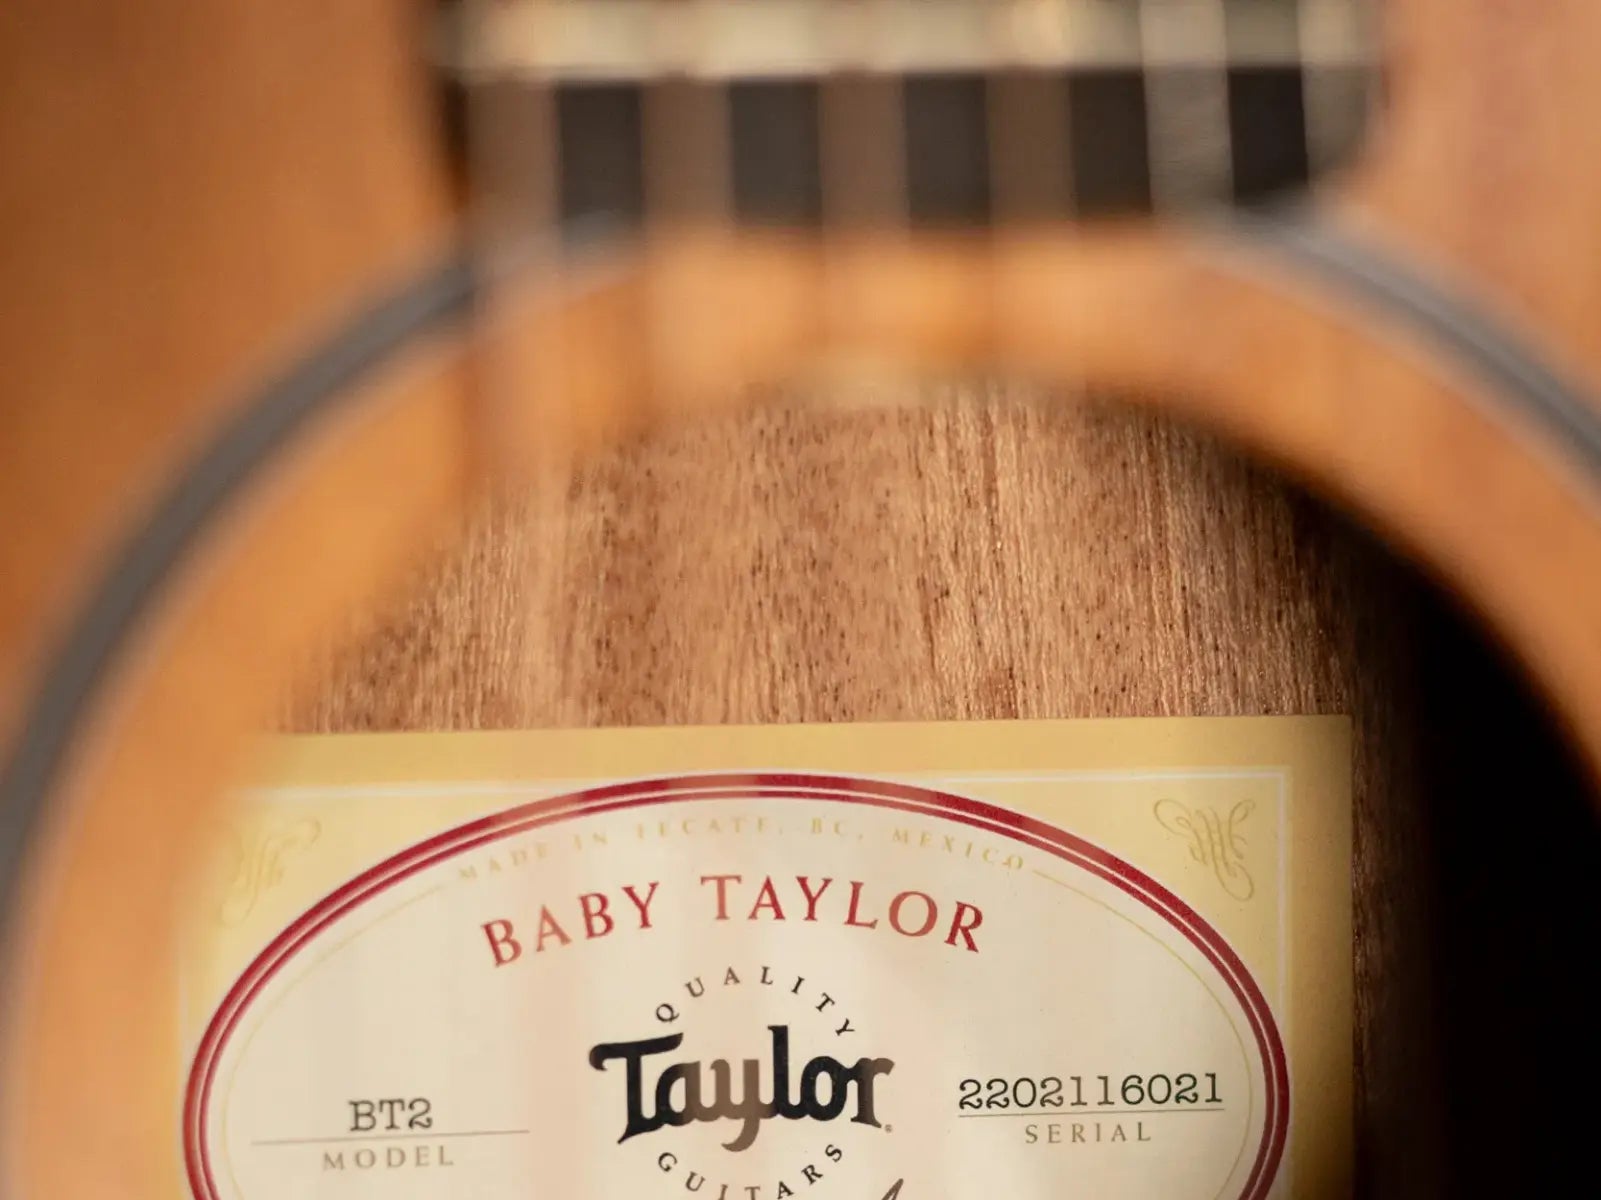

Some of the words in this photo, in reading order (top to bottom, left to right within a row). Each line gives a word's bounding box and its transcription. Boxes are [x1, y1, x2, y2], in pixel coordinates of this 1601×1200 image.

[458, 843, 549, 880] MADE
[571, 830, 609, 851] IN
[891, 827, 1025, 871] MEXICO
[481, 881, 662, 968] BABY
[700, 874, 986, 954] TAYLOR
[654, 965, 856, 1038] QUALITY
[588, 1024, 896, 1153] Taylor
[957, 1072, 1224, 1110] 2202116021
[348, 1097, 434, 1132] BT2
[1024, 1121, 1153, 1145] SERIAL
[321, 1144, 455, 1172] MODEL
